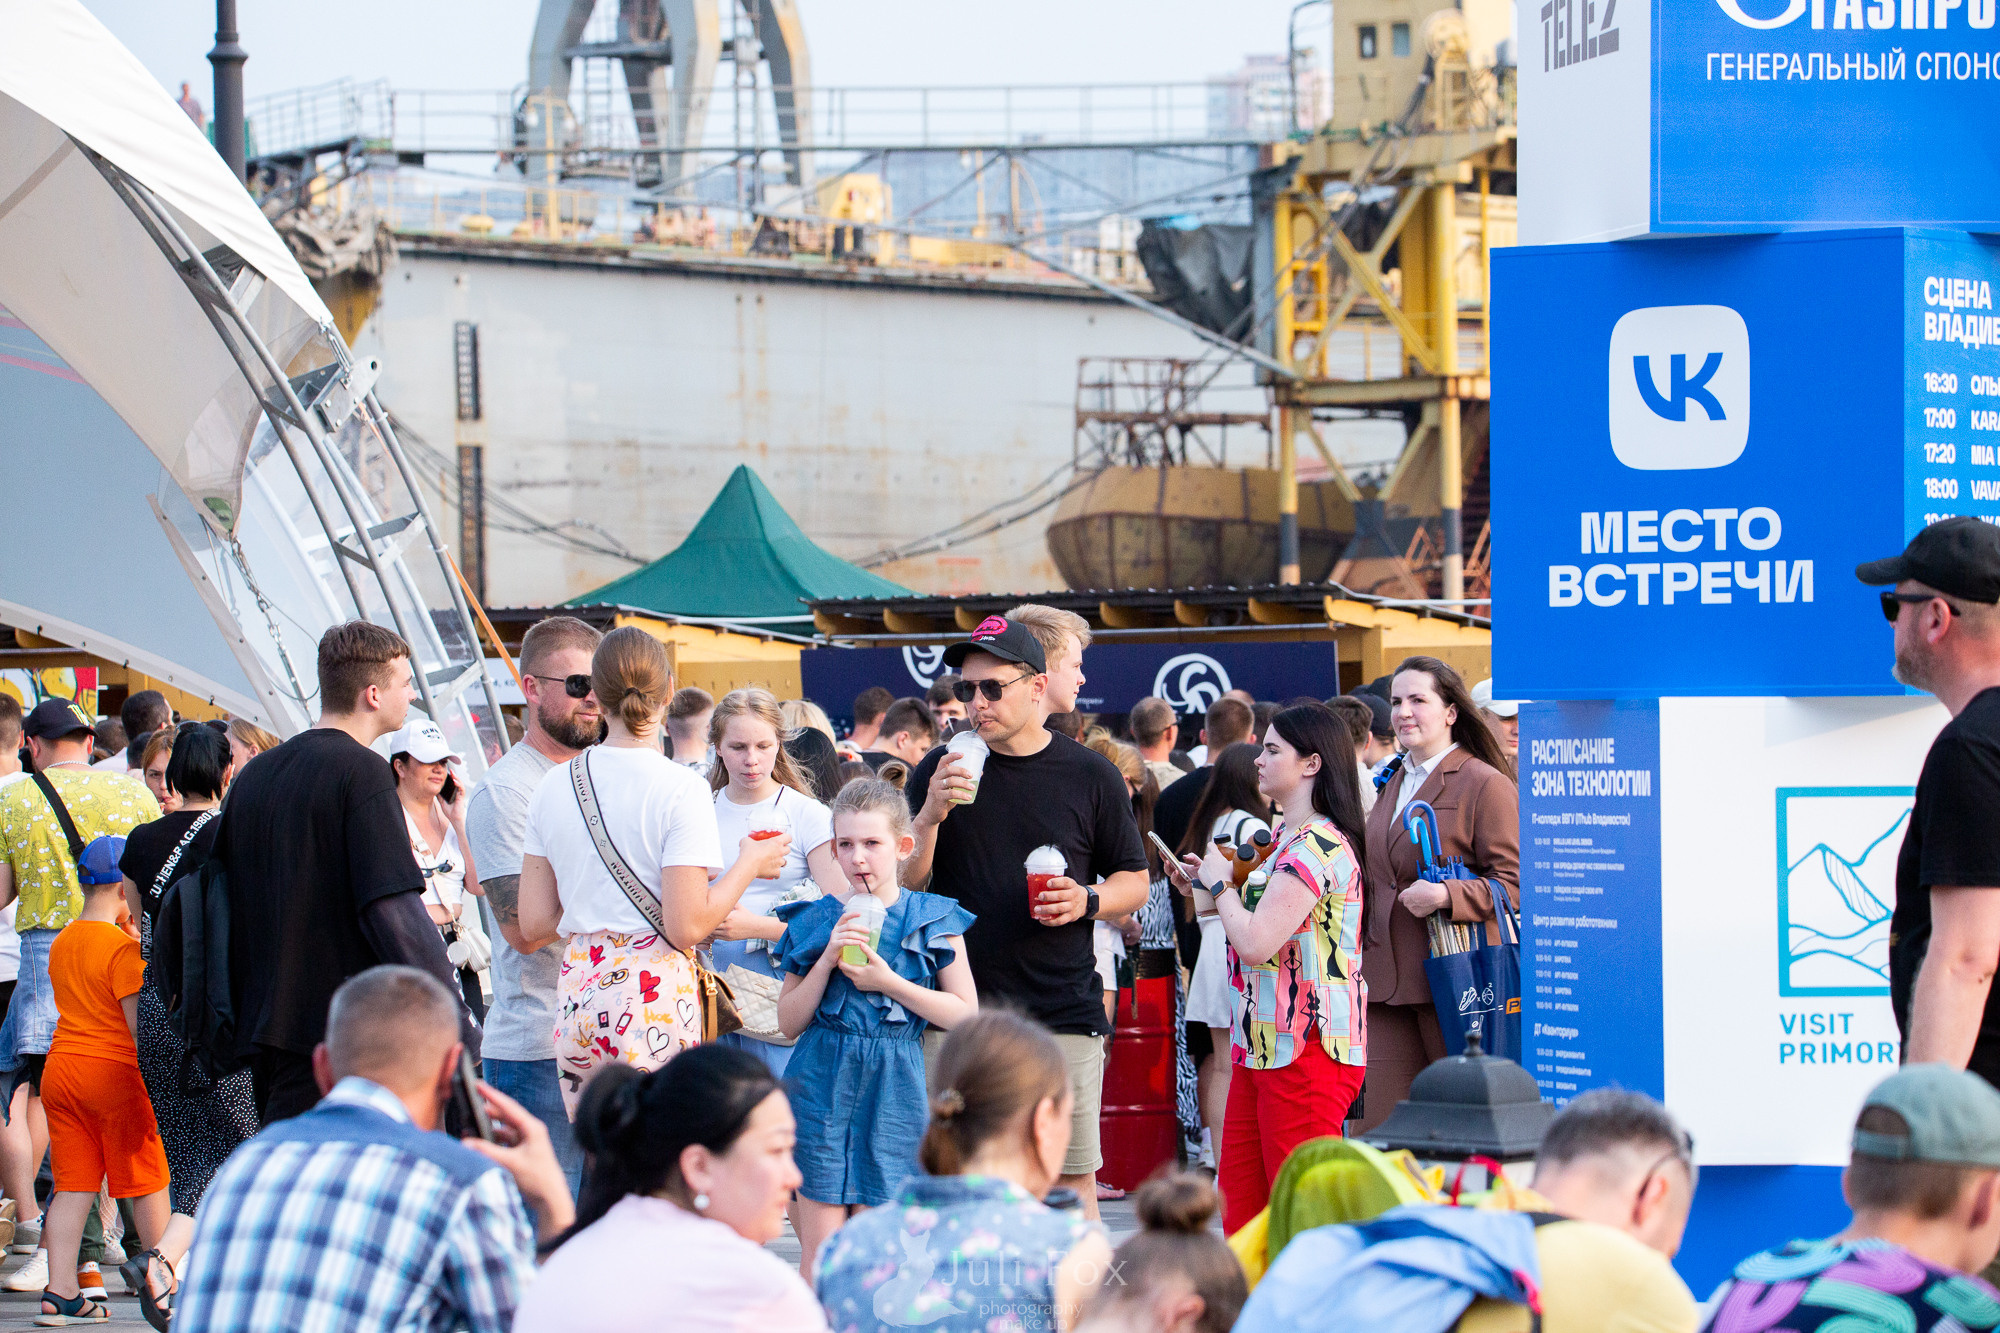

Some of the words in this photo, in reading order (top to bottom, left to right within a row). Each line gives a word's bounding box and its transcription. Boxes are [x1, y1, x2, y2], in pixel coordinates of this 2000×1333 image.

[1706, 47, 1906, 81] ГЕНЕРАЛЬНЫЙ
[1924, 276, 1993, 313] СЦЕНА
[1632, 352, 1727, 422] VK
[1923, 372, 1958, 394] 16:30
[1970, 374, 2000, 397] ОЛЬ
[1923, 407, 1957, 429] 17:00
[1970, 410, 2000, 431] KAR
[1923, 442, 1957, 464] 17:20
[1970, 445, 1995, 466] MIA
[1923, 477, 1959, 499] 18:00
[1581, 507, 1782, 554] МЕСТО
[1549, 560, 1814, 608] ВСТРЕЧИ
[1531, 737, 1615, 765] РАСПИСАНИЕ
[1531, 770, 1566, 797] ЗОНА
[1567, 769, 1652, 797] ТЕХНОЛОГИИ
[1779, 1013, 1854, 1035] VISIT
[1779, 1041, 1900, 1064] PRIMOR
